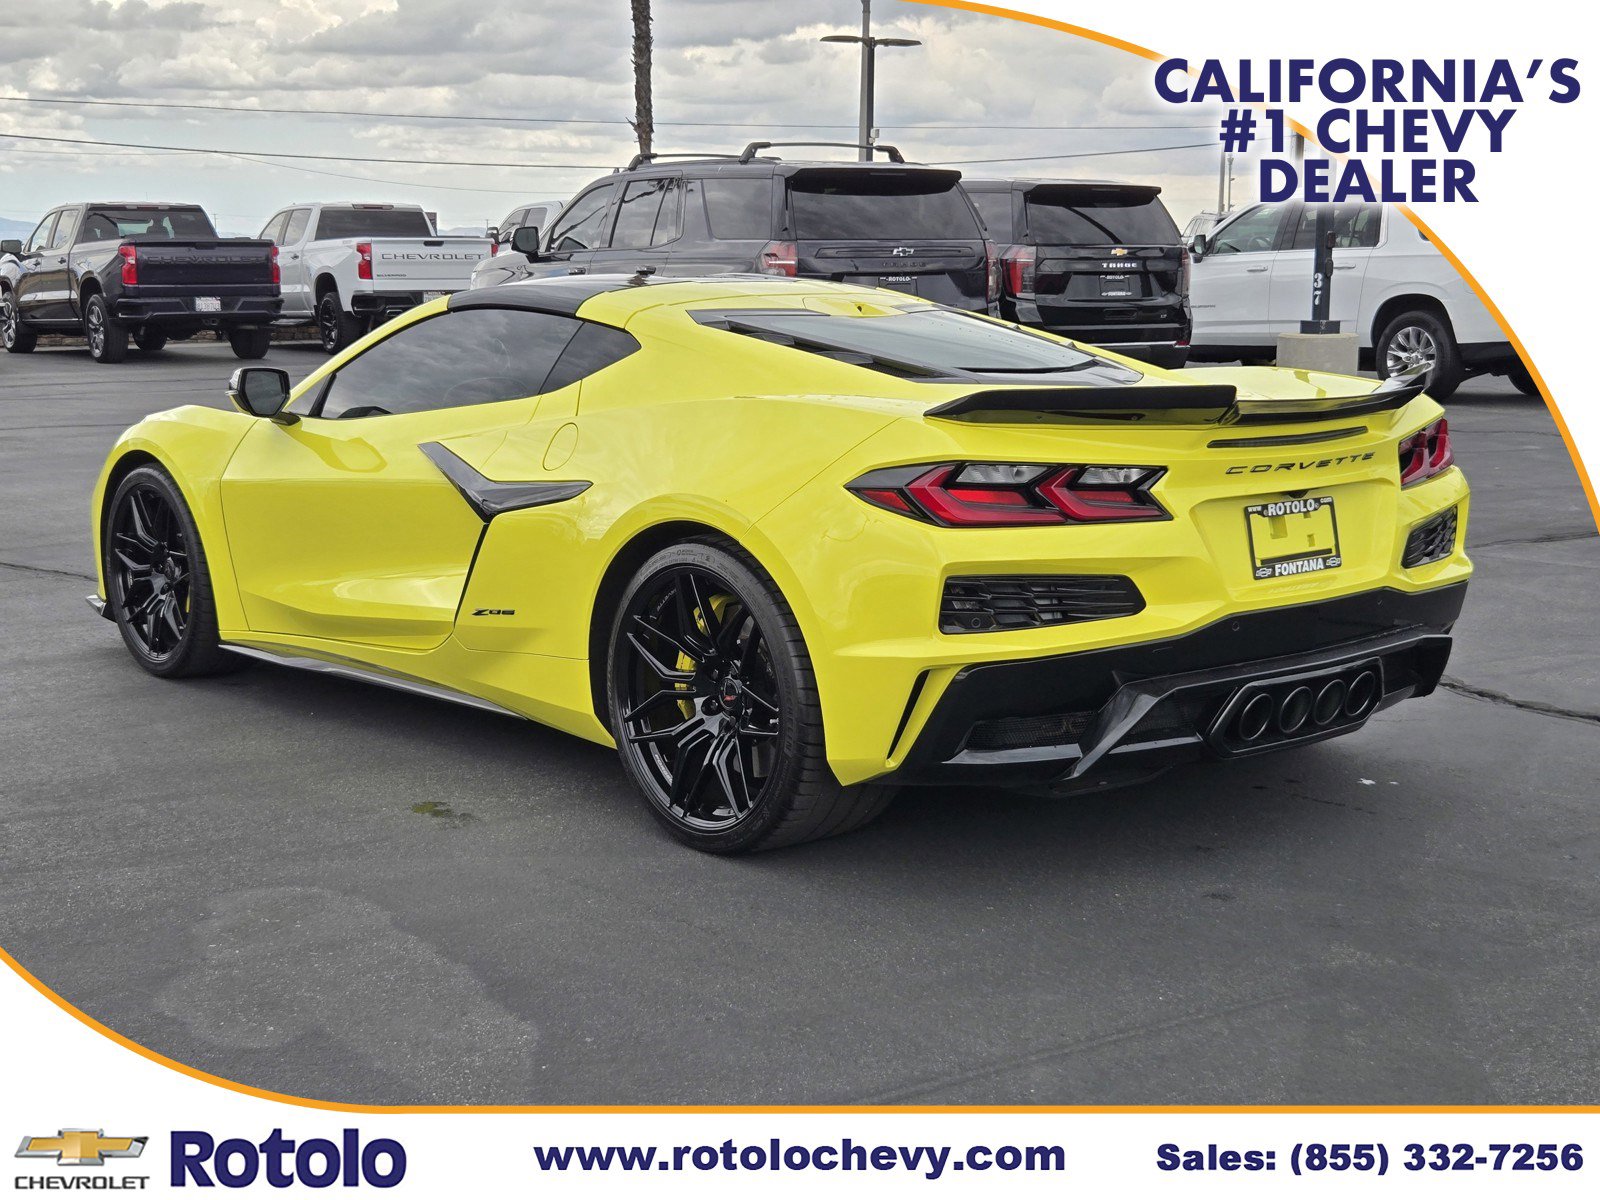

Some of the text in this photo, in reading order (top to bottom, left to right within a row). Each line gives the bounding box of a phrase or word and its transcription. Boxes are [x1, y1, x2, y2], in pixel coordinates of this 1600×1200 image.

[147, 255, 266, 264] CHEVROLET
[381, 253, 484, 261] CHEVROLET
[1313, 272, 1323, 306] 37
[1225, 452, 1376, 475] CORVETTE
[1267, 499, 1314, 516] ROTOLO
[1275, 558, 1324, 577] FONTANA
